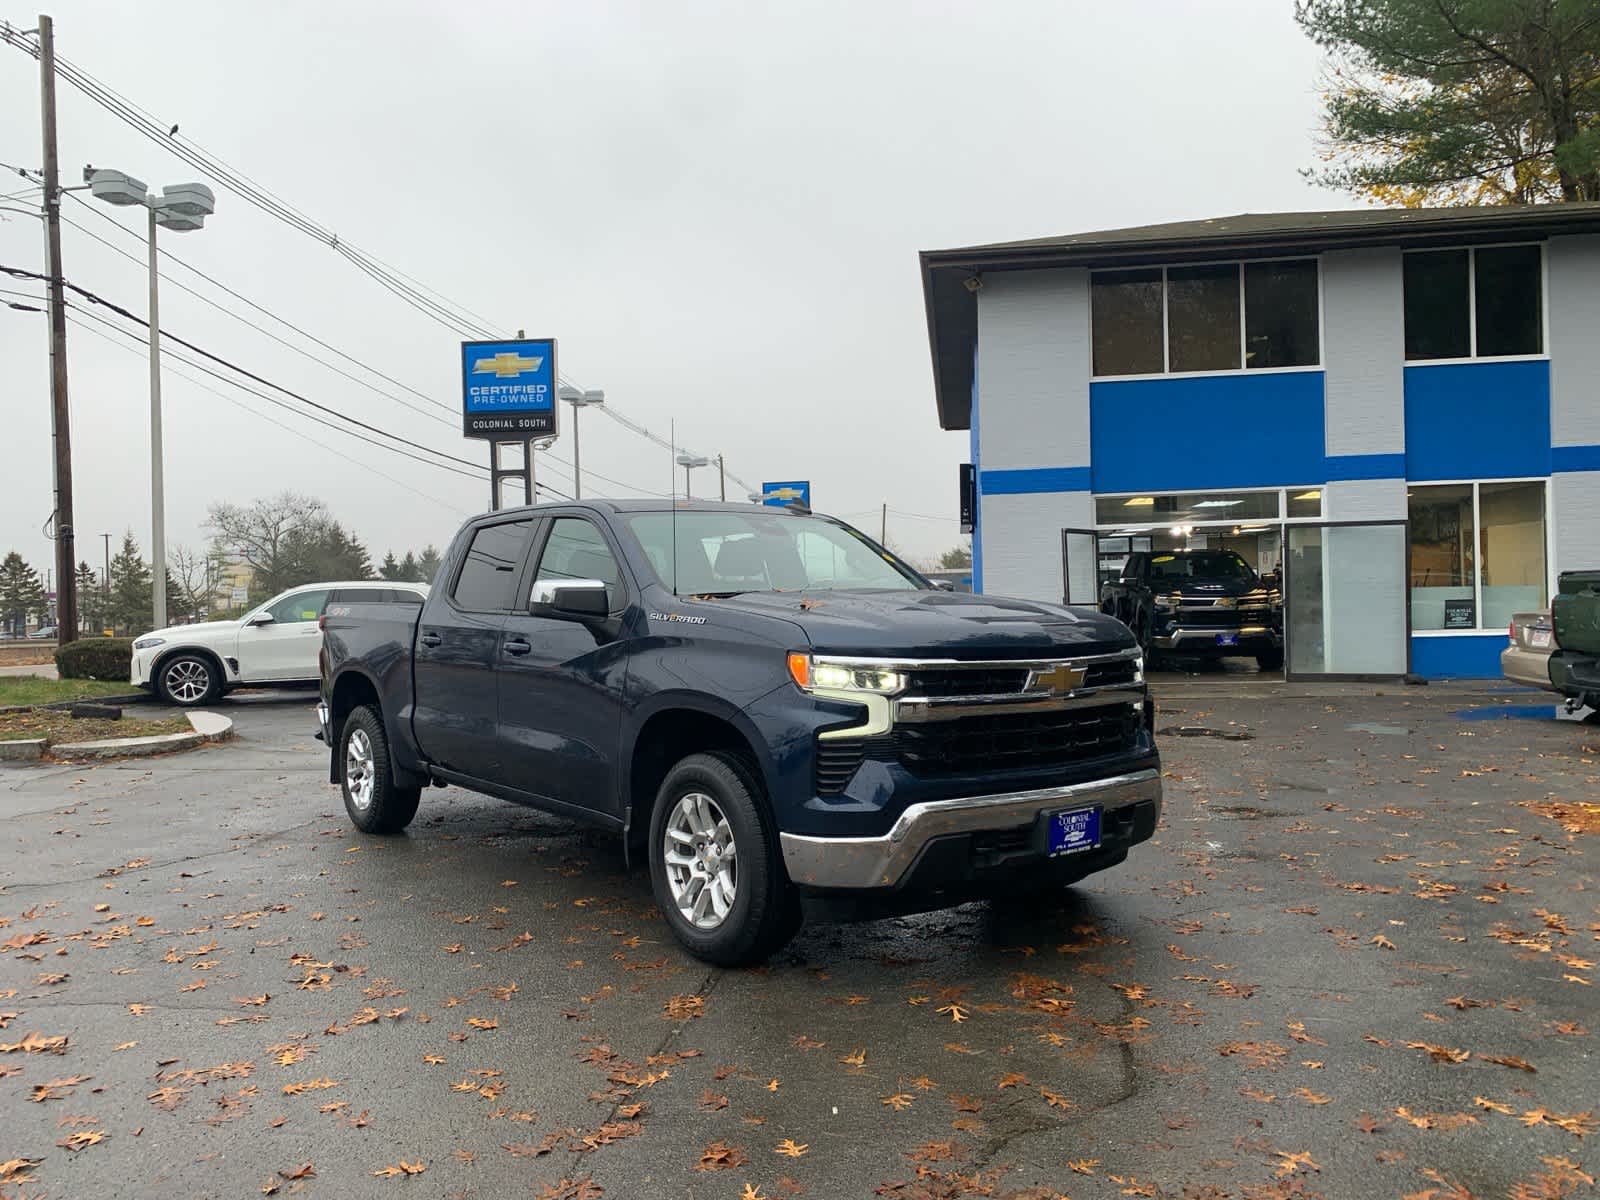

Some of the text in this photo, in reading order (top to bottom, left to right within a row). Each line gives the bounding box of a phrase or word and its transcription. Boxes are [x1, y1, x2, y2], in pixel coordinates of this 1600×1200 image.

[470, 385, 547, 396] CERTIFIED
[473, 394, 544, 404] PRE-OWNED
[472, 419, 546, 429] COLONIAL SOUTH
[649, 612, 706, 625] SILVERADO
[1058, 813, 1090, 826] COLONIAL
[1063, 822, 1086, 833] SOUTH
